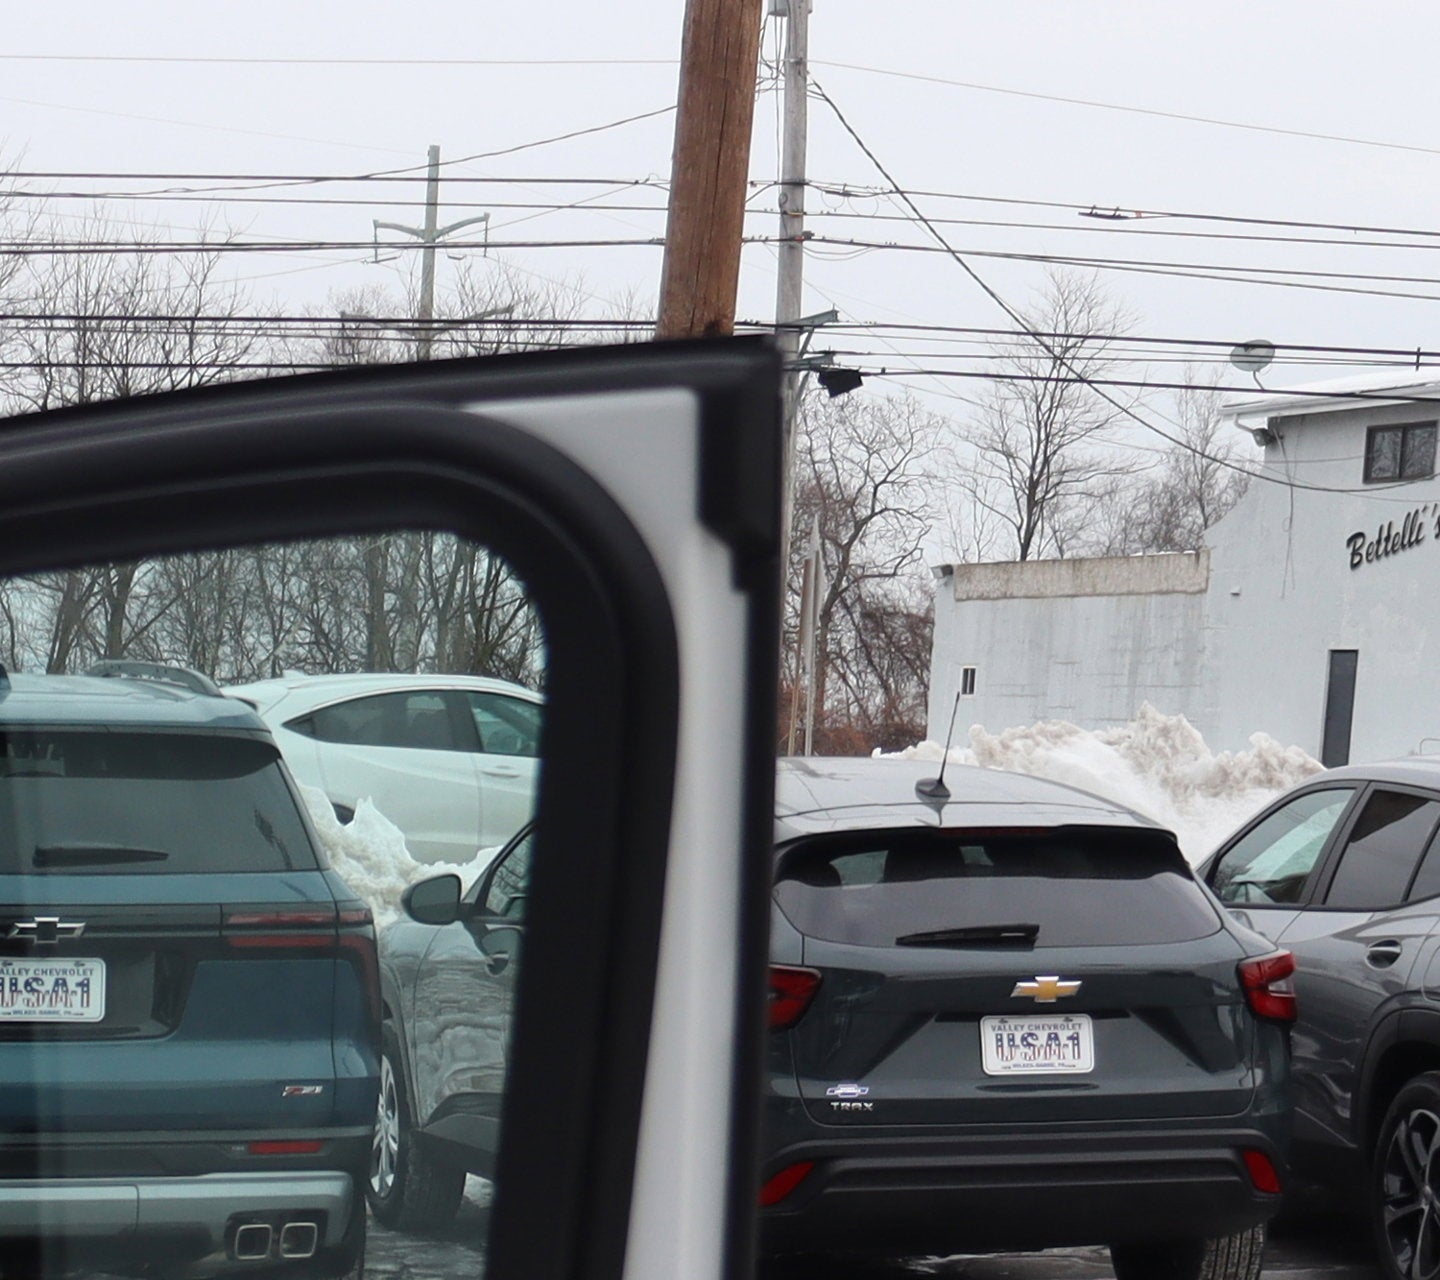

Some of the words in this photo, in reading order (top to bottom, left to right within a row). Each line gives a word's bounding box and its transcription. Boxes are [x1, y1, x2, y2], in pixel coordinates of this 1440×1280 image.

[33, 967, 95, 976] CHEVROLET
[991, 1024, 1025, 1032] VALLEY
[1027, 1022, 1083, 1032] CHEVROLET
[830, 1101, 874, 1111] TRAX
